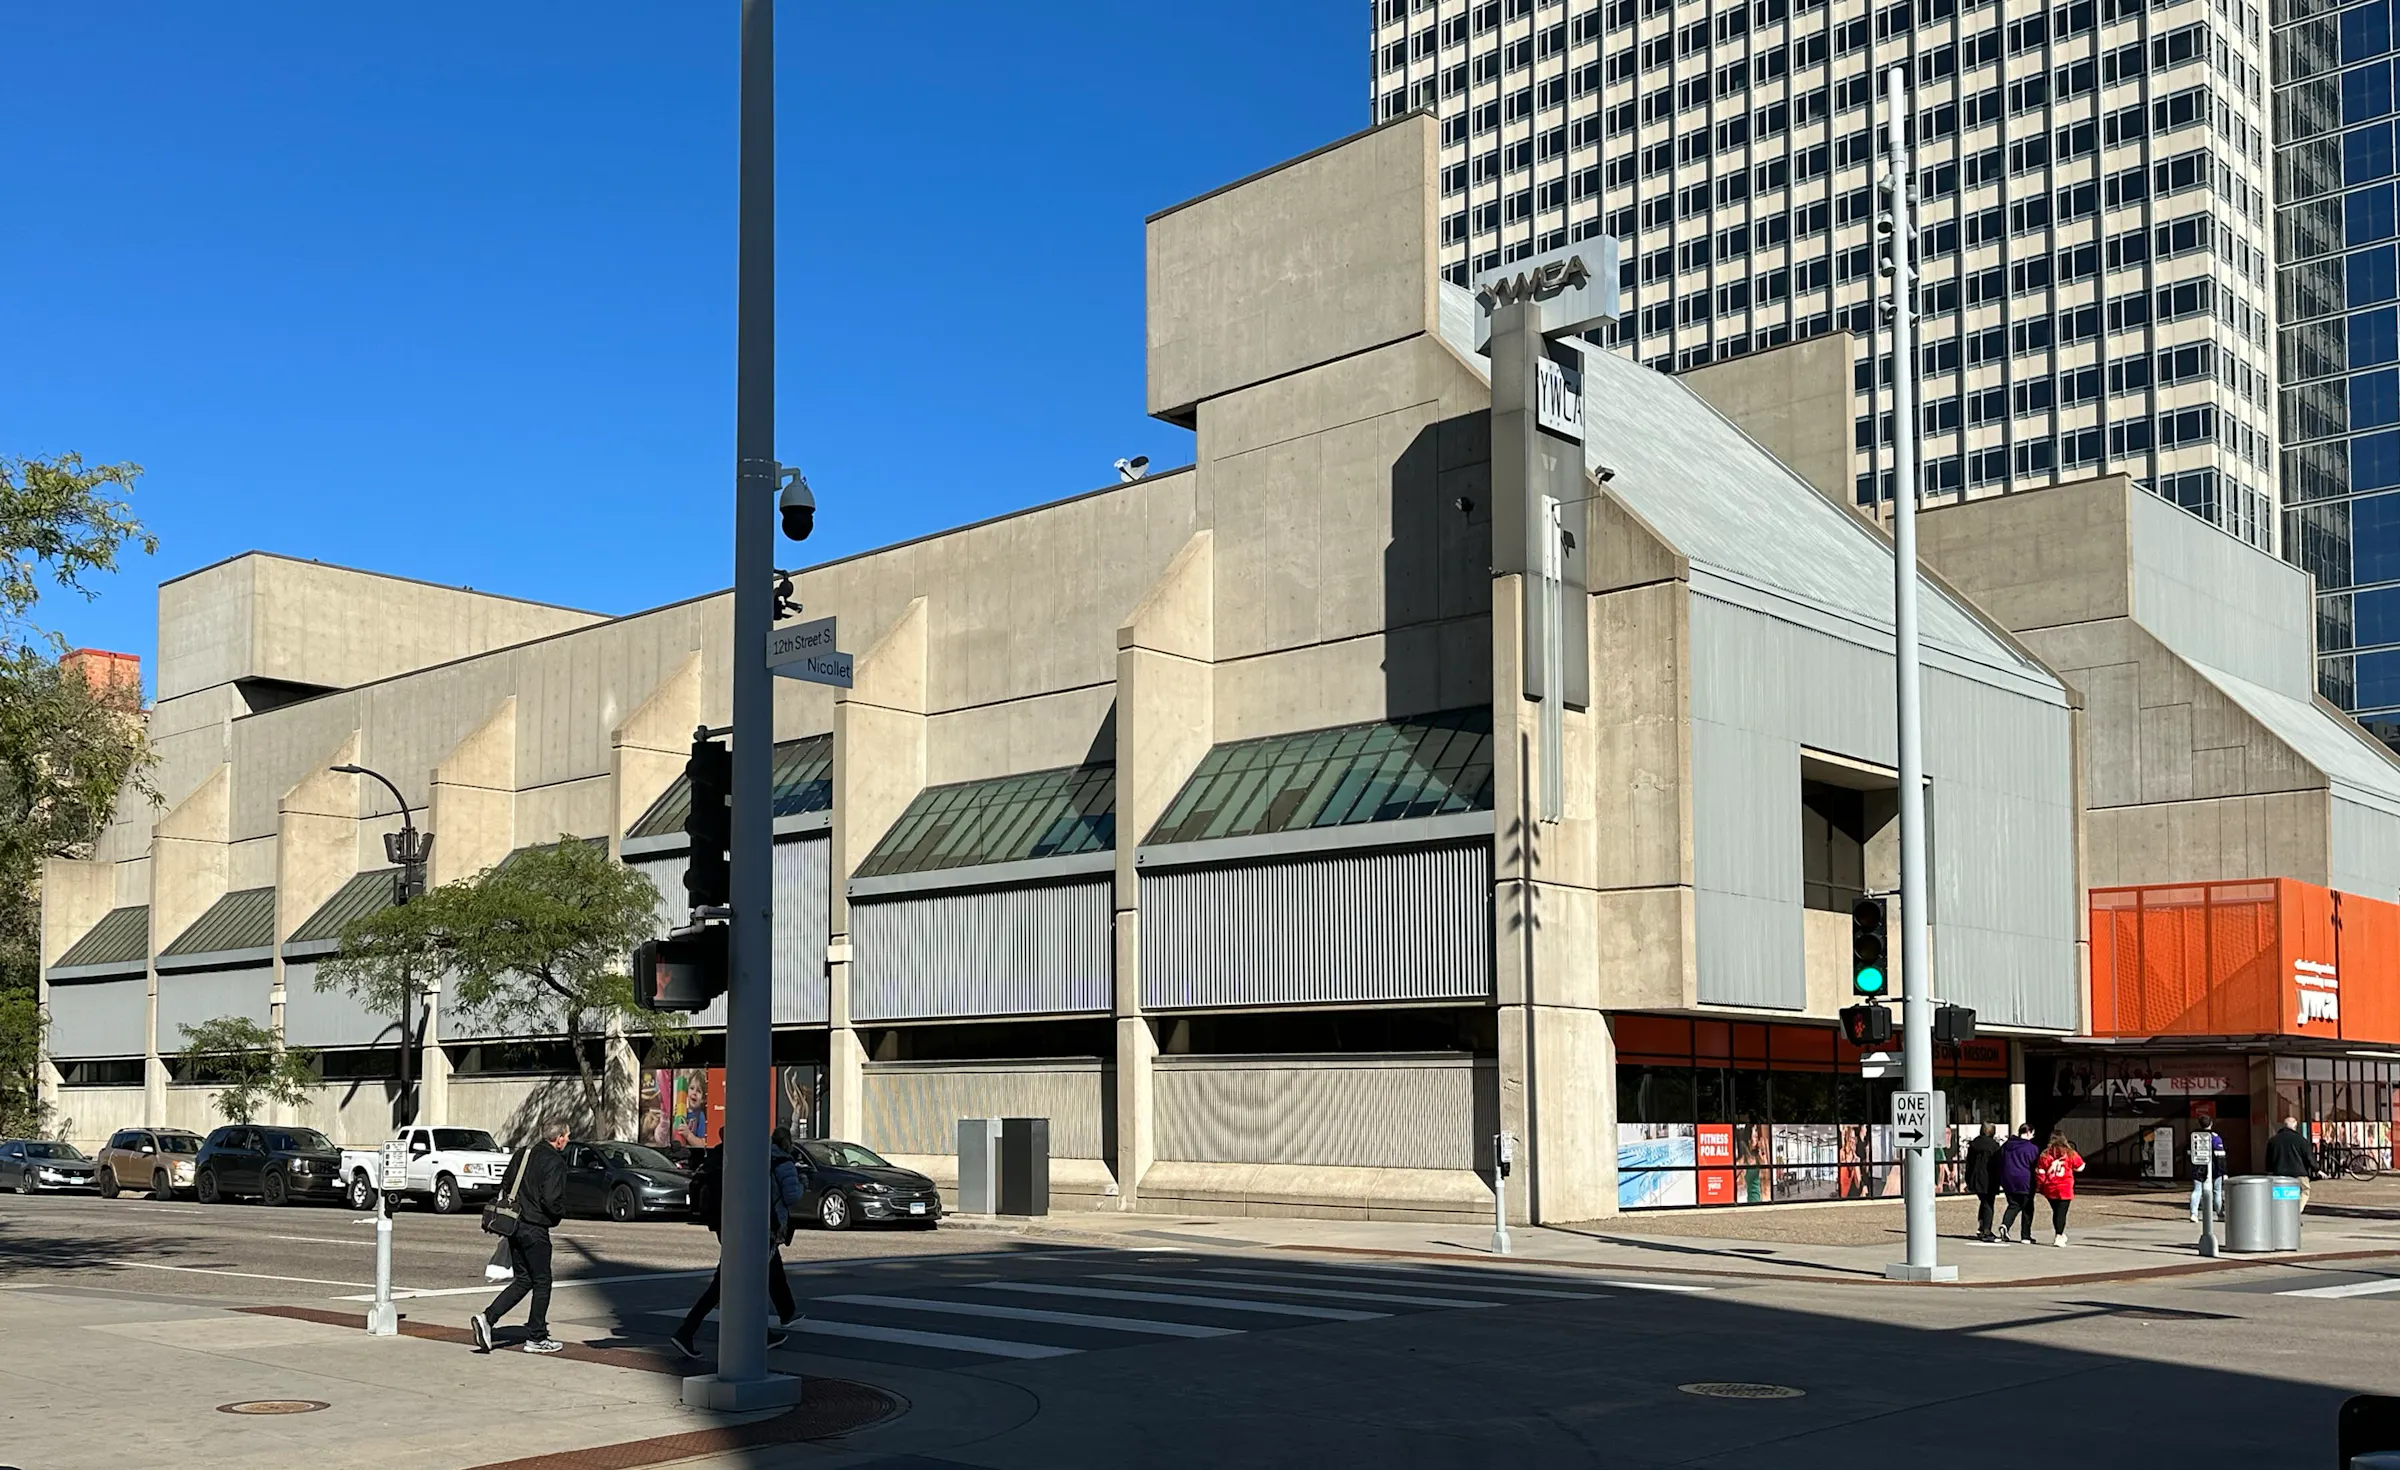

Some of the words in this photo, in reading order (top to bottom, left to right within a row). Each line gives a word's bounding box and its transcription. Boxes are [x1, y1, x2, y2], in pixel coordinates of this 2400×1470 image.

[1481, 254, 1591, 304] YWCA
[1540, 369, 1583, 426] YWCA
[773, 638, 794, 655] 12th
[795, 632, 822, 650] Street
[807, 658, 851, 678] Nicollet
[1964, 1046, 1999, 1062] MISSION
[1898, 1097, 1925, 1110] ONE
[1897, 1113, 1925, 1126] WAY
[1700, 1134, 1729, 1144] FITNESS
[1701, 1146, 1715, 1156] FOR
[1716, 1146, 1729, 1156] ALL
